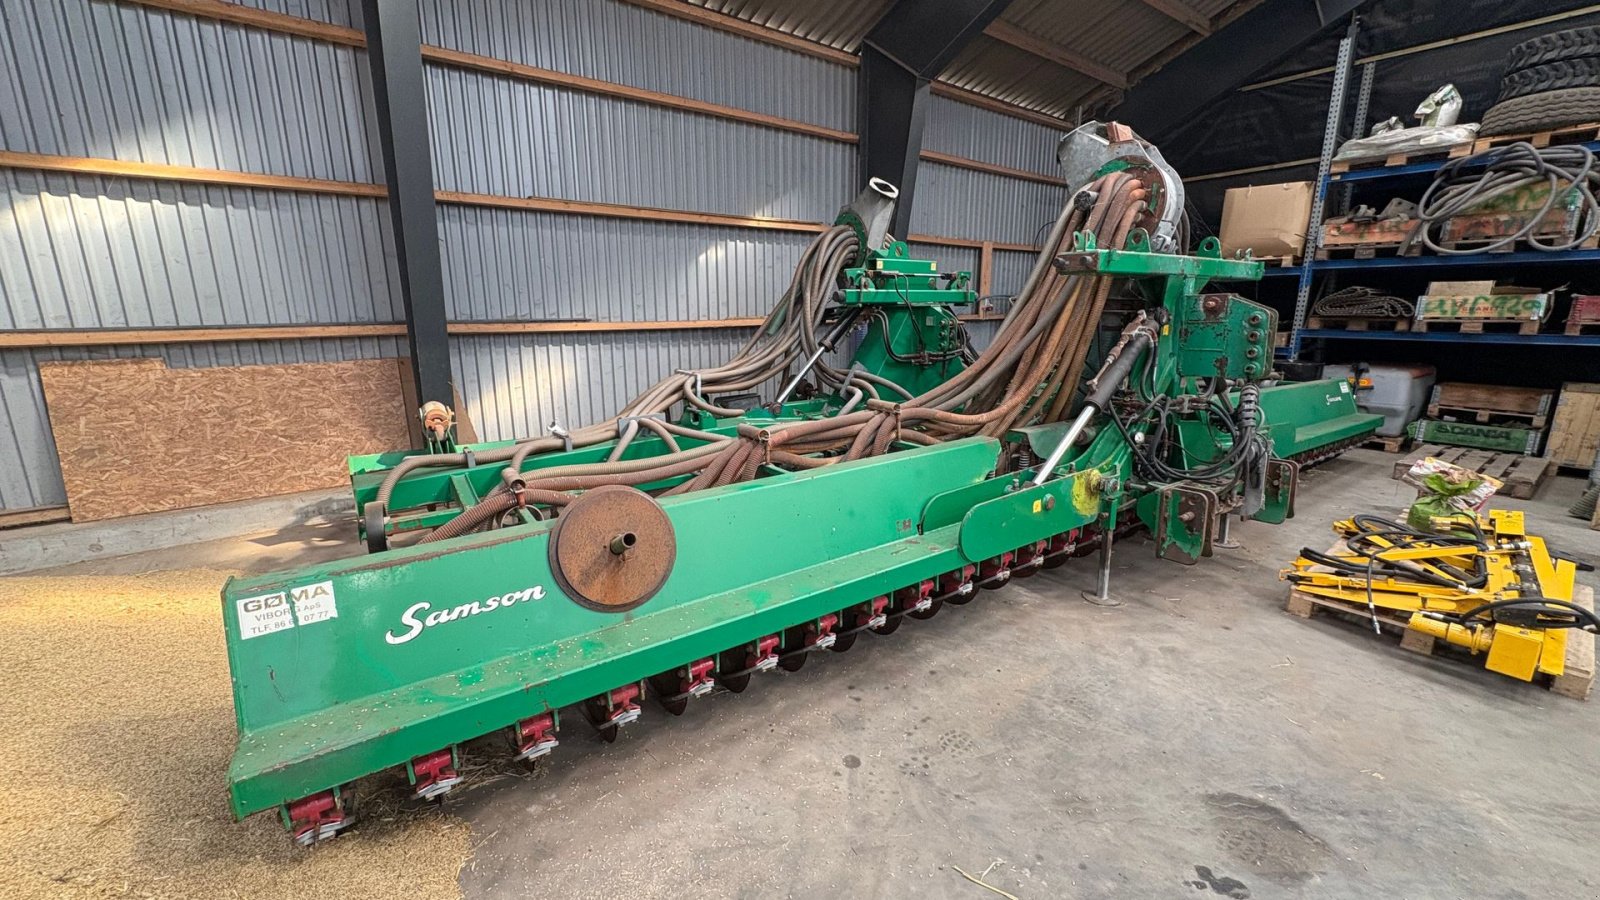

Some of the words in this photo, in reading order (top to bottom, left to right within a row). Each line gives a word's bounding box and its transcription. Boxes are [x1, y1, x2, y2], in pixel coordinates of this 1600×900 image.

[304, 602, 321, 611] ApS
[274, 620, 286, 629] 86
[304, 613, 314, 622] 07
[385, 585, 547, 645] Samson
